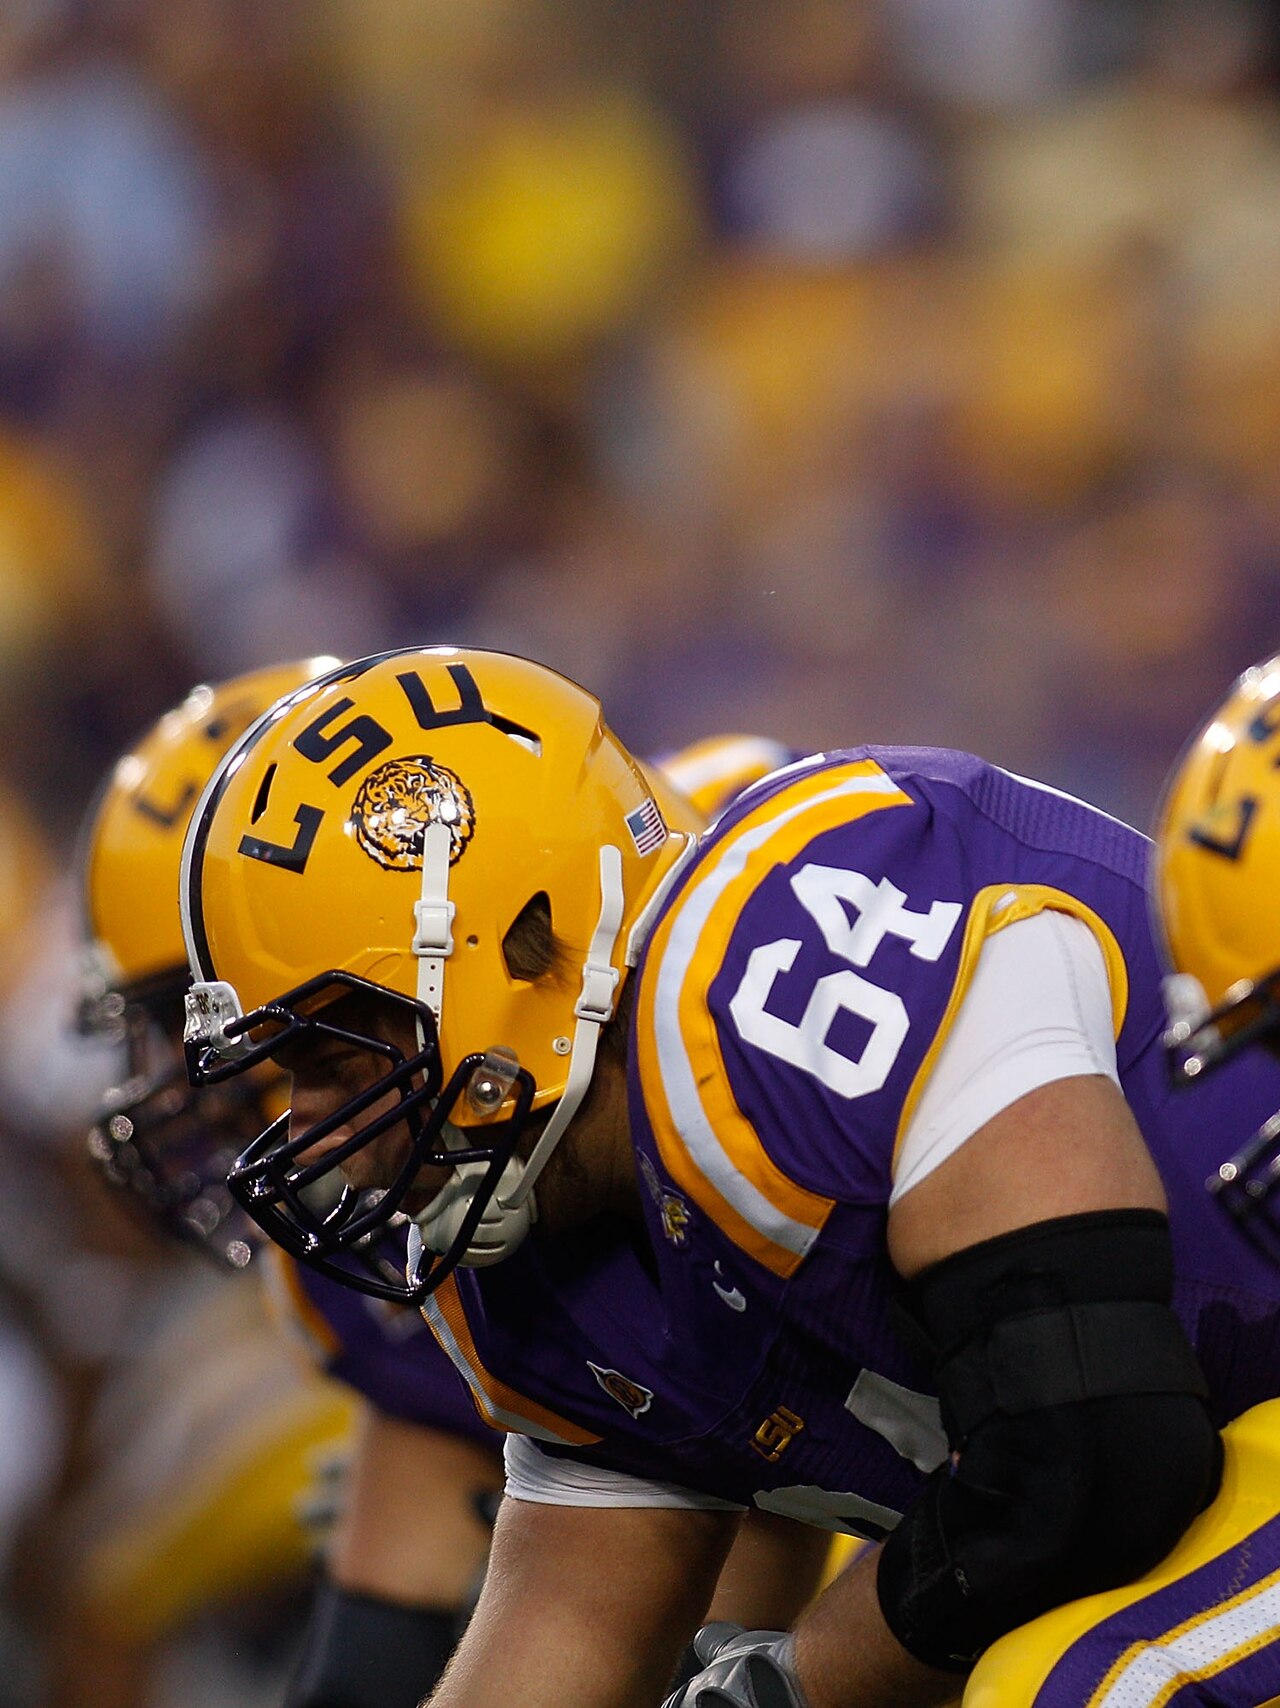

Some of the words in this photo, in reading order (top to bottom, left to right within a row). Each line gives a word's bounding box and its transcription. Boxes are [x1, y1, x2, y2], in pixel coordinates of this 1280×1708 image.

[238, 664, 495, 874] LSU
[729, 863, 963, 1099] 64
[747, 1405, 804, 1462] LSU
